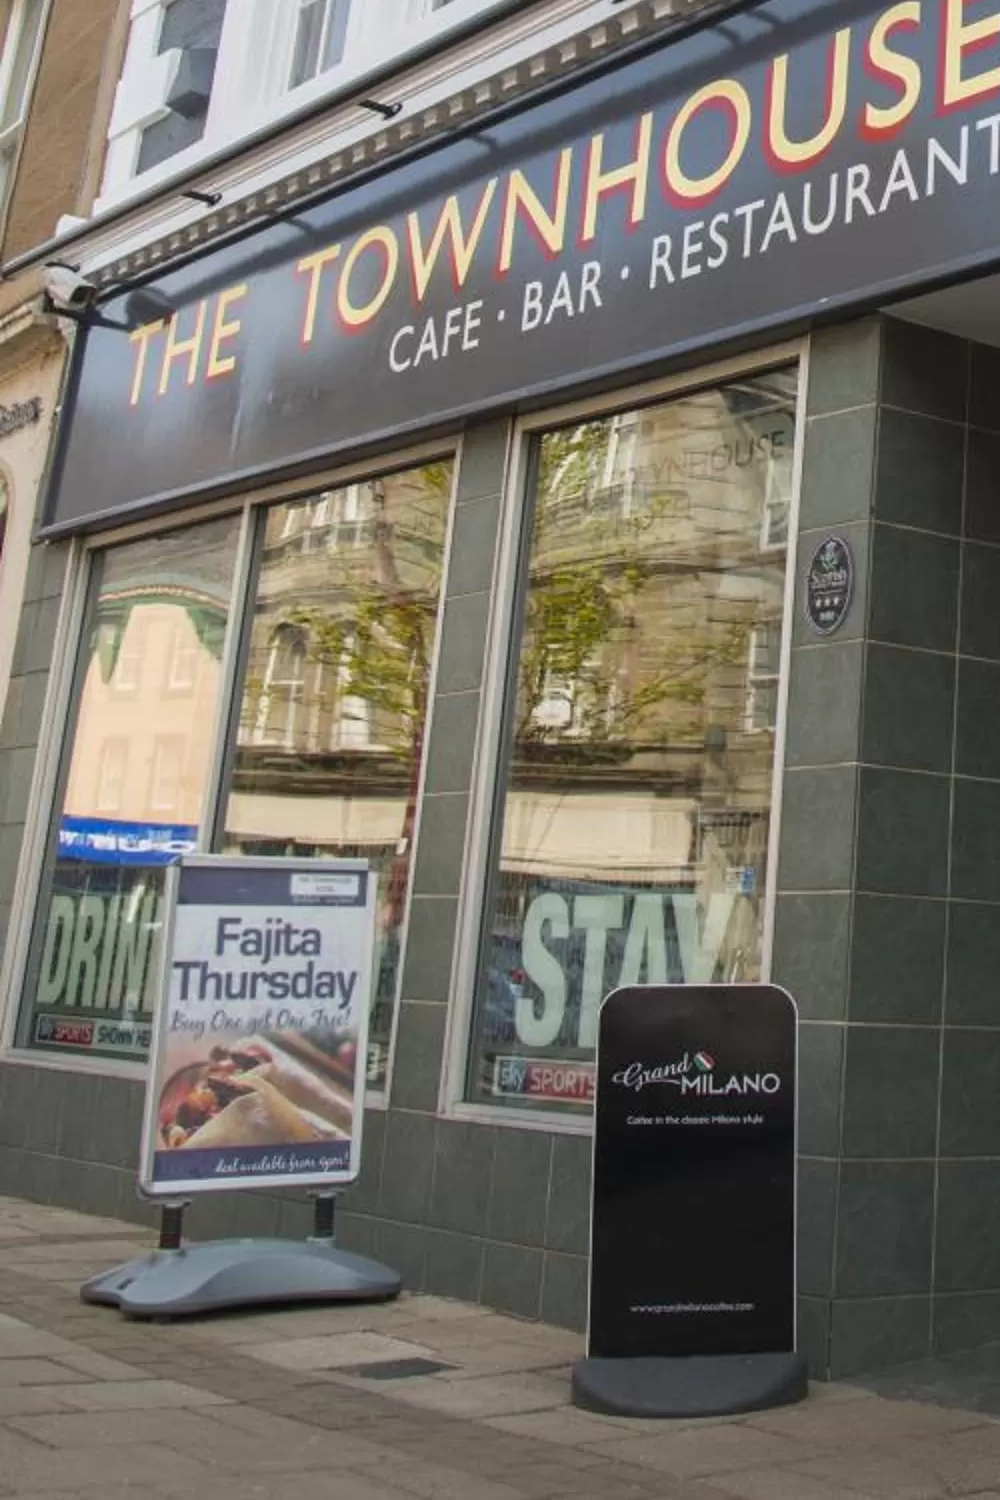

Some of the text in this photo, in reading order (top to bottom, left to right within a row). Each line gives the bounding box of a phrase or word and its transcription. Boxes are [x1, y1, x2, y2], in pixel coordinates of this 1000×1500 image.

[388, 300, 484, 373] CAFE
[521, 261, 603, 332] BAR
[129, 284, 248, 407] THE
[214, 917, 322, 965] Fajita
[172, 961, 359, 1010] Thursday
[210, 1008, 241, 1032] One
[276, 1008, 305, 1030] One
[612, 1052, 693, 1092] Grand
[680, 1073, 781, 1096] MILANO
